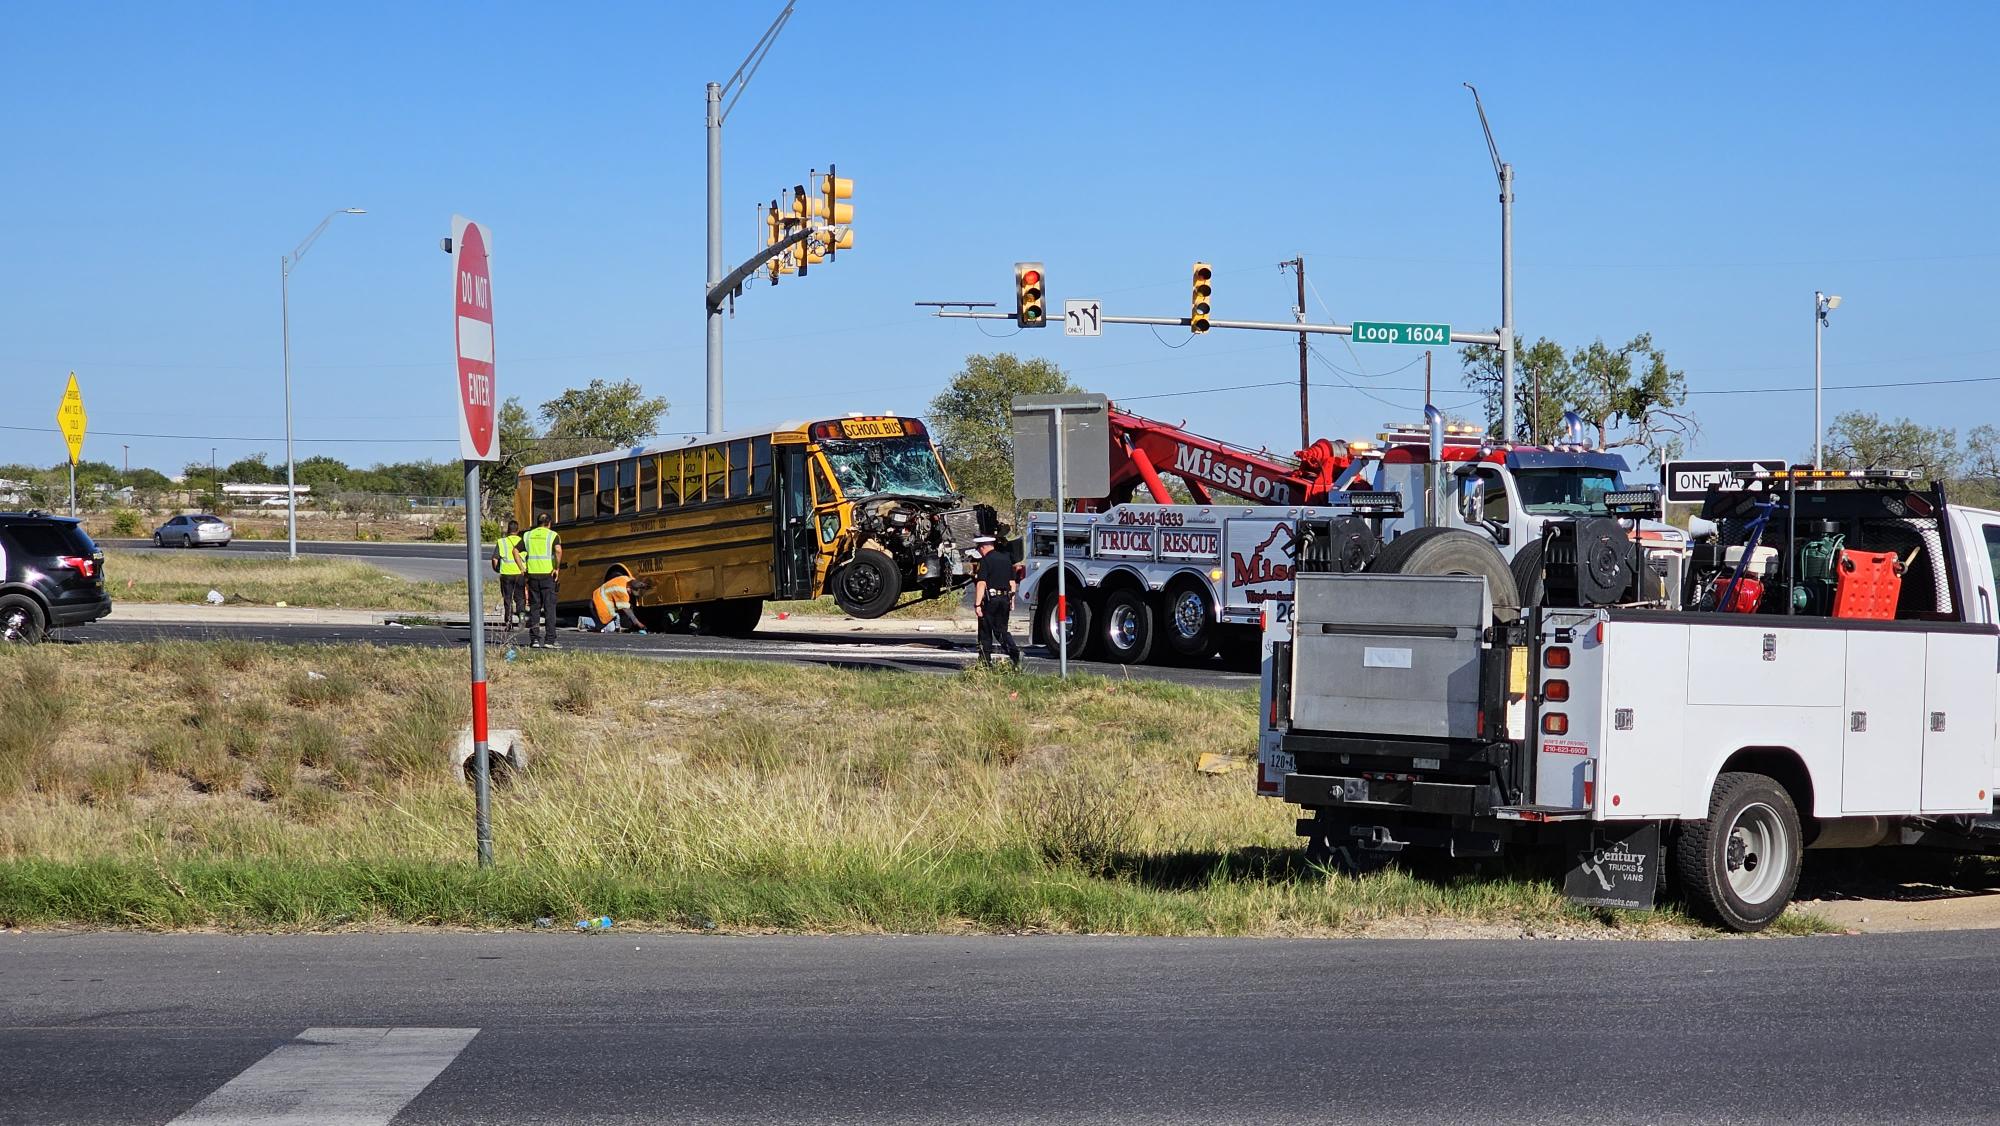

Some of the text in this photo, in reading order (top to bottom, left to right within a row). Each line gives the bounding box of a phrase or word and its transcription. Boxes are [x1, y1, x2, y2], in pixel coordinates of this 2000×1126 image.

[461, 271, 487, 309] DO NOT
[1067, 326, 1083, 334] ONLY
[1358, 324, 1444, 344] Loop 1604
[468, 373, 490, 407] ENTER
[844, 421, 901, 437] SCHOOL BUS
[1174, 442, 1290, 502] Mission
[1680, 474, 1742, 490] ONE WA
[1118, 511, 1184, 527] 210-341-0333
[1099, 530, 1218, 554] TRUCK RESCUE
[1594, 847, 1647, 866] Century
[1608, 863, 1644, 873] TRUCKS &
[1622, 873, 1644, 882] VANS
